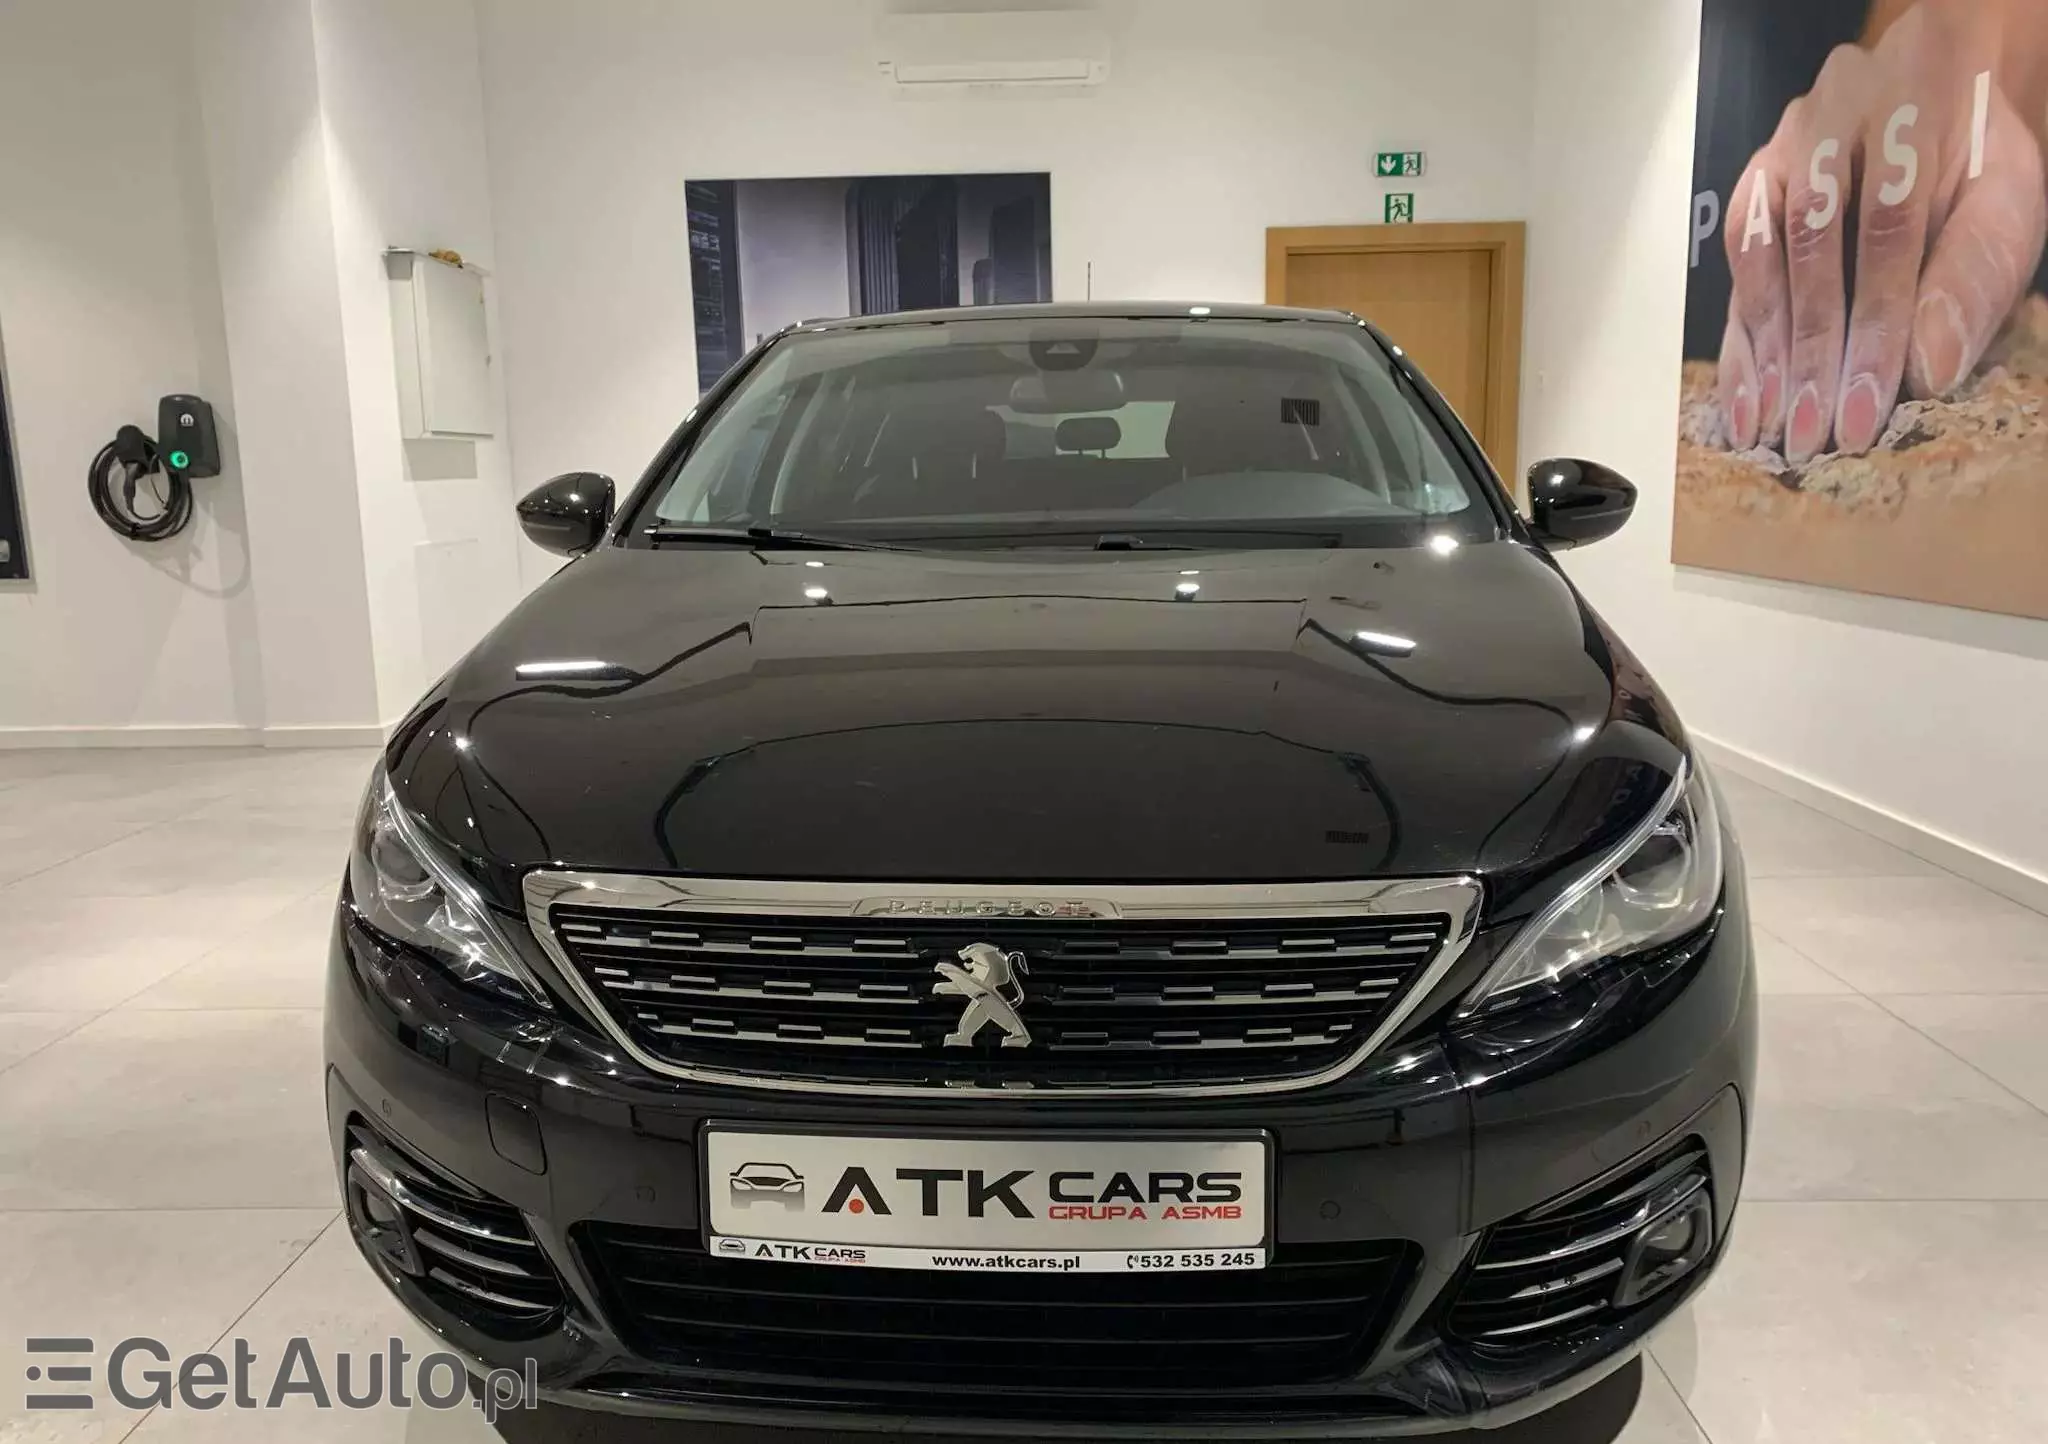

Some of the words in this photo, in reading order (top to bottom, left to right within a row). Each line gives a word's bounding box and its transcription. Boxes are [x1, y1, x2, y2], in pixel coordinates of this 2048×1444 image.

[1689, 70, 1990, 268] PASSI
[889, 900, 1087, 916] PEUGEOT
[821, 1166, 1035, 1219] ATK
[1049, 1172, 1242, 1203] CARS
[1049, 1206, 1147, 1220] GRUPA
[1161, 1206, 1242, 1220] ASMB
[755, 1243, 811, 1260] ATK
[814, 1247, 866, 1259] CARS
[932, 1255, 1080, 1271] www.atkcars.pl
[1140, 1255, 1174, 1268] 532
[1181, 1255, 1214, 1267] 535
[1221, 1253, 1255, 1266] 245
